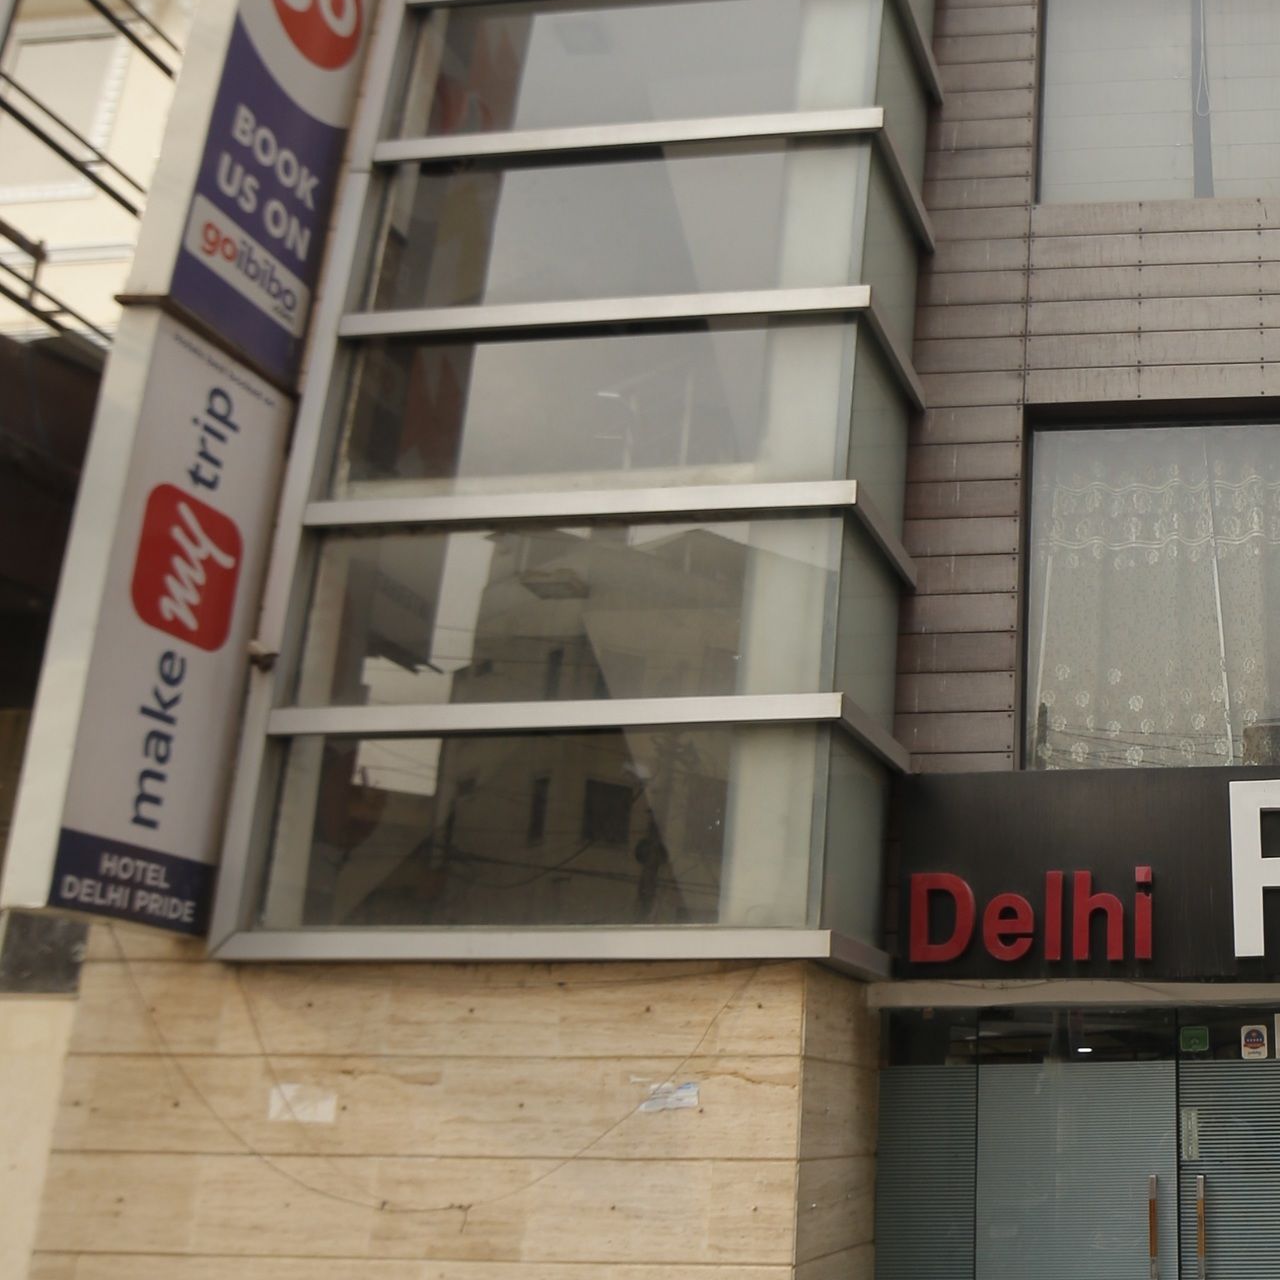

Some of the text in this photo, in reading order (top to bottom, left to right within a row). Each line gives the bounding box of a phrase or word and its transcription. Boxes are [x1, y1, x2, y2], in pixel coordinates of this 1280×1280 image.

[216, 151, 312, 262] US ON
[231, 102, 320, 211] BOOK
[201, 221, 297, 311] goibibo
[188, 387, 240, 491] trip
[159, 501, 236, 631] my
[131, 650, 187, 830] make
[61, 874, 197, 923] DELHI PRIDE
[100, 852, 171, 890] HOTEL
[908, 865, 1154, 964] Delhi
